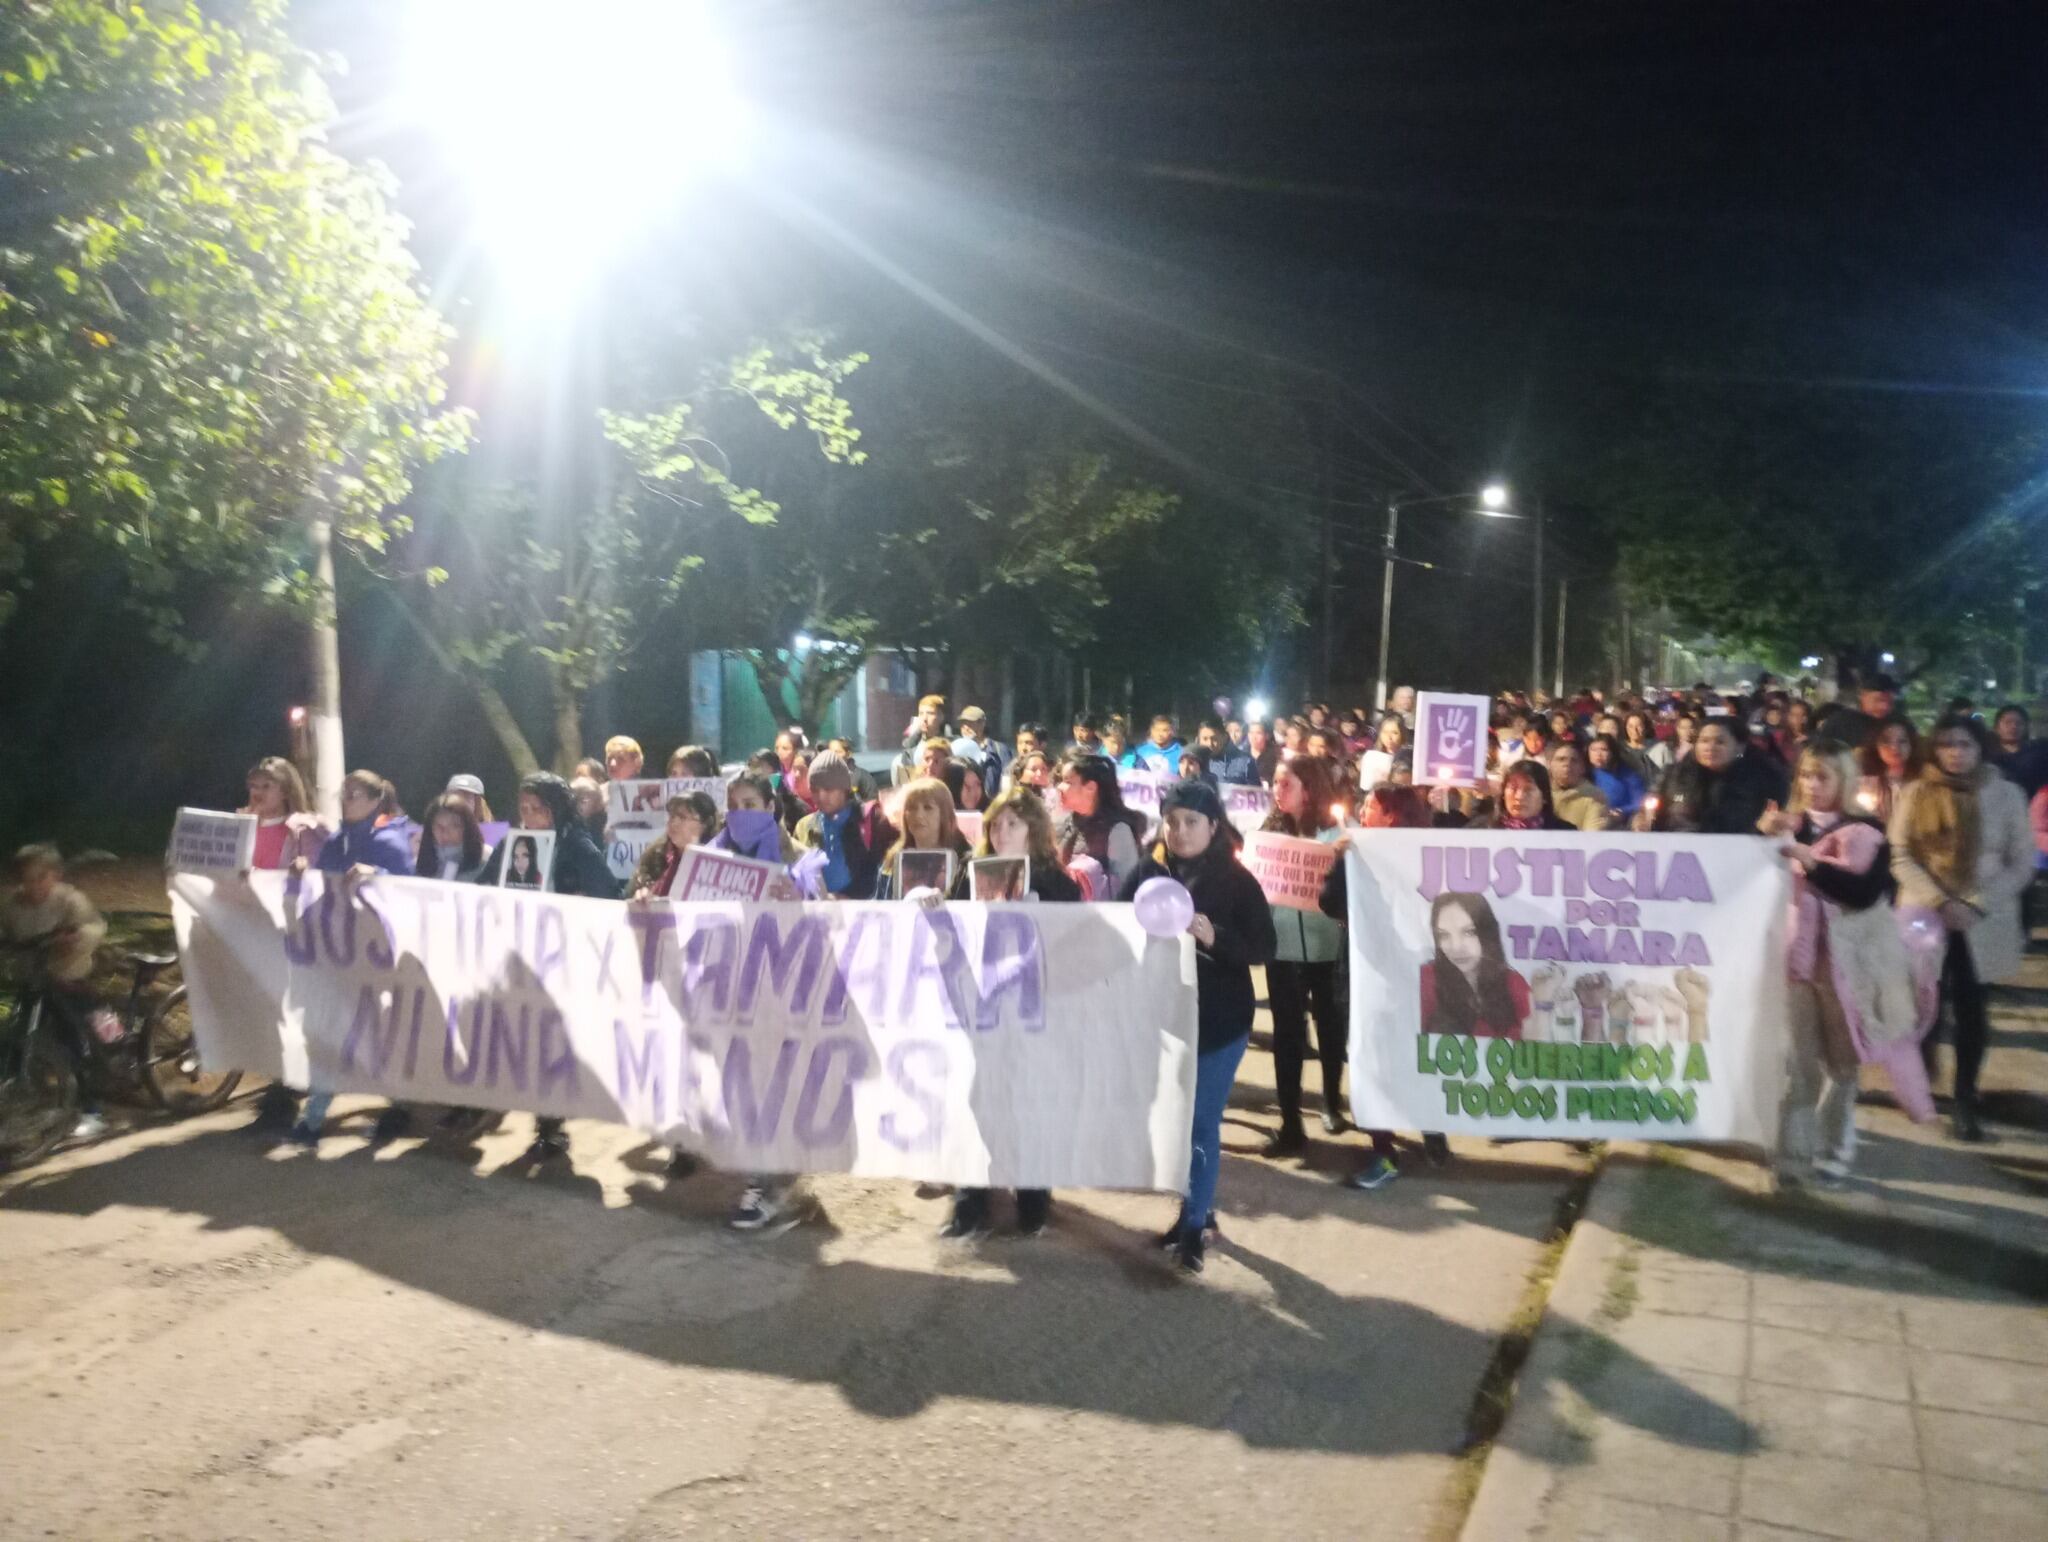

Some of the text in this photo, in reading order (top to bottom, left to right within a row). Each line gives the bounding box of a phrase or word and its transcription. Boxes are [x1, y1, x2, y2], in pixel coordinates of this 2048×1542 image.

[695, 859, 760, 896] NI UNA
[1283, 866, 1301, 881] QUE
[1303, 870, 1315, 884] YA
[1290, 849, 1301, 864] EL
[1417, 846, 1715, 904] JUSTICIA
[1565, 898, 1642, 928] POR
[284, 872, 572, 984] JUSTICIA
[622, 908, 1046, 1033] TAMARA
[1507, 924, 1713, 967] TAMARA
[340, 984, 426, 1082] NI
[441, 994, 583, 1101] UNA
[1416, 1033, 1711, 1085] LOS QUEREMOS A
[1442, 1080, 1699, 1125] TODOS PRESOS
